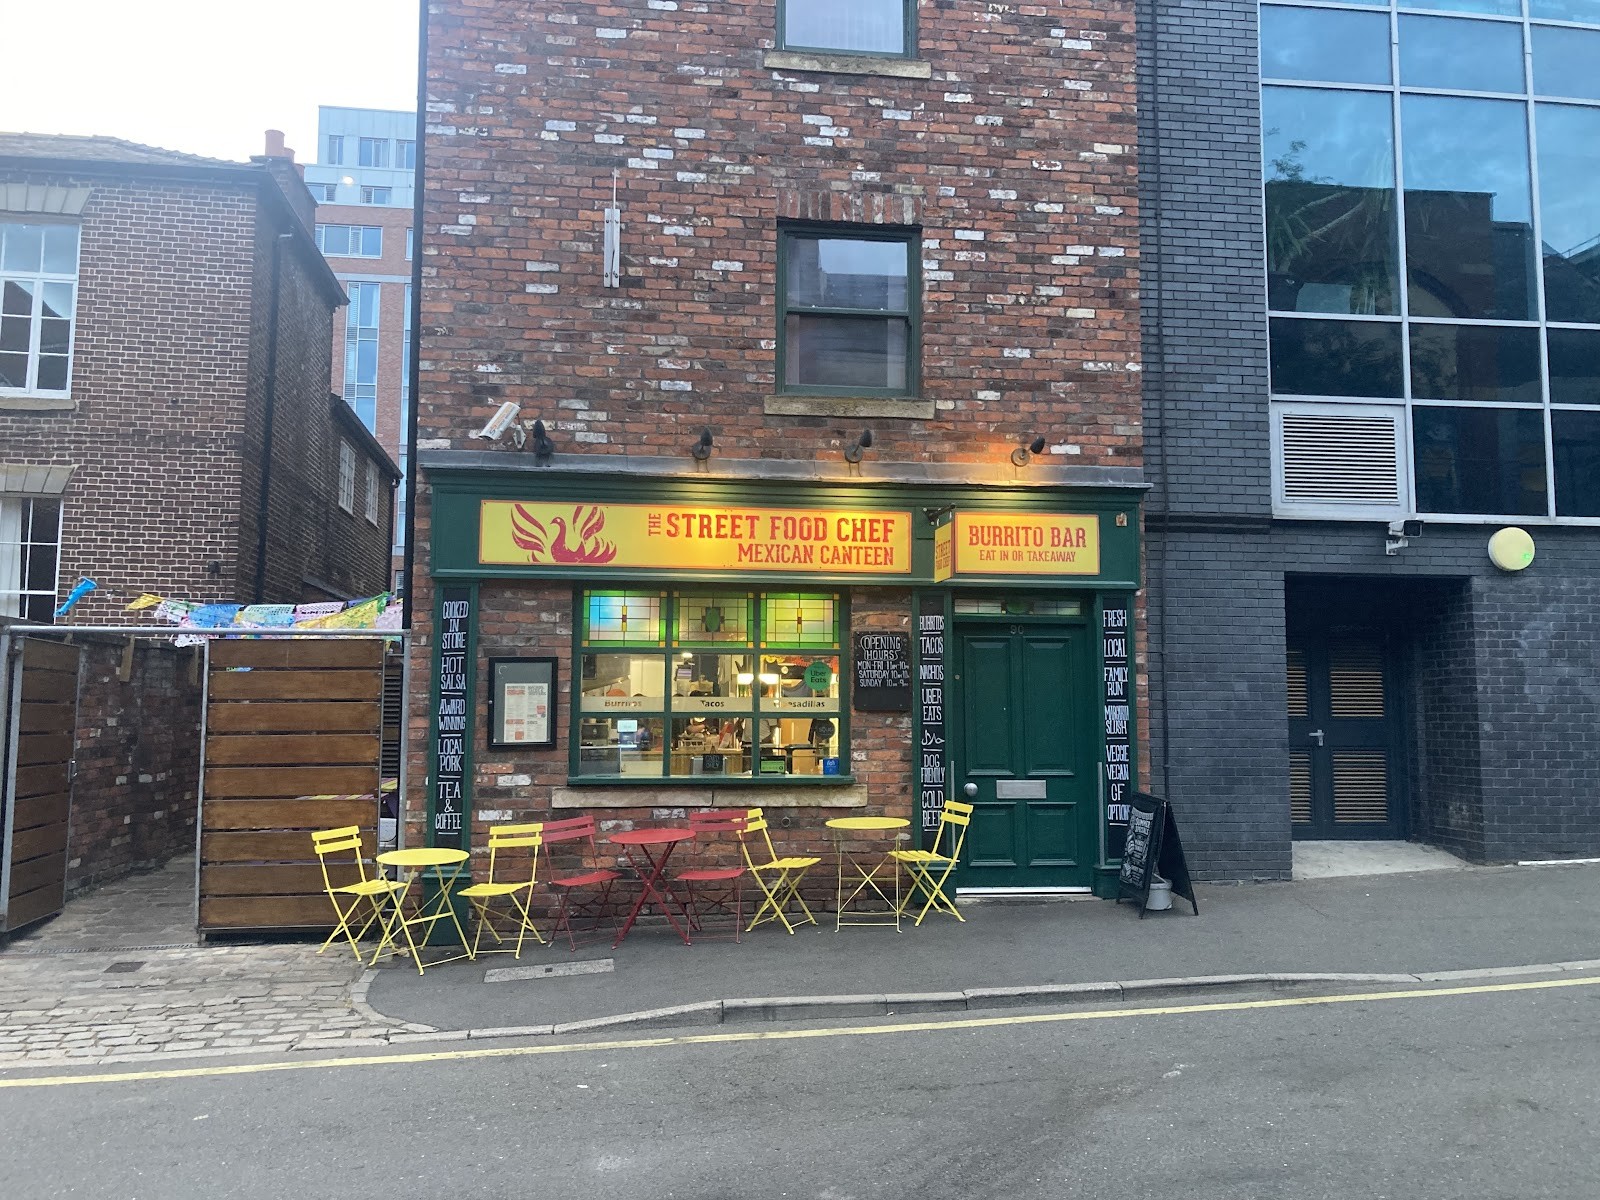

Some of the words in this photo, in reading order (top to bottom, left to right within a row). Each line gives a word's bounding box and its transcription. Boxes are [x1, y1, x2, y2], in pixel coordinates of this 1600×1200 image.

[649, 513, 661, 536] THE
[666, 513, 760, 540] STREET
[769, 516, 828, 541] FOOD
[837, 518, 895, 543] CHEF
[968, 525, 1044, 547] BURRITO
[1051, 527, 1087, 548] BAR
[737, 543, 814, 564] MEXICAN
[820, 545, 894, 566] CANTEEN
[979, 550, 997, 561] EAT
[1000, 550, 1009, 561] IN
[1012, 551, 1024, 562] OR
[1027, 551, 1076, 562] TAKEAWAY
[443, 601, 469, 619] COOKED
[1103, 609, 1128, 627] FRESH
[449, 619, 460, 632] IN
[919, 615, 944, 631] BURRITOS
[442, 632, 466, 649] STORE
[864, 637, 901, 650] OPENING
[920, 637, 944, 654] TACOS
[1103, 639, 1127, 657] LOCAL
[866, 650, 895, 660] HOURS
[441, 657, 465, 674] HOT
[920, 665, 944, 680] NACHOS
[441, 674, 466, 690] SALSA
[859, 670, 890, 679] SATURDAY
[1104, 667, 1128, 682] FAMILY
[859, 679, 882, 687] SUNDAY
[1107, 682, 1123, 695] RUN
[922, 688, 942, 704] UBER
[439, 699, 466, 714] AWARD
[923, 705, 942, 721] EATS
[438, 716, 466, 730] WINNING
[1105, 721, 1127, 734] SLUSH
[438, 739, 464, 755] LOCAL
[1106, 745, 1129, 761] VEGGIE
[440, 755, 462, 771] PORK
[924, 754, 940, 768] DOG
[1106, 764, 1129, 780] VEGAN
[438, 782, 461, 799] TEA
[444, 799, 454, 813] &
[922, 791, 944, 808] COLD
[435, 813, 462, 829] COFFEE
